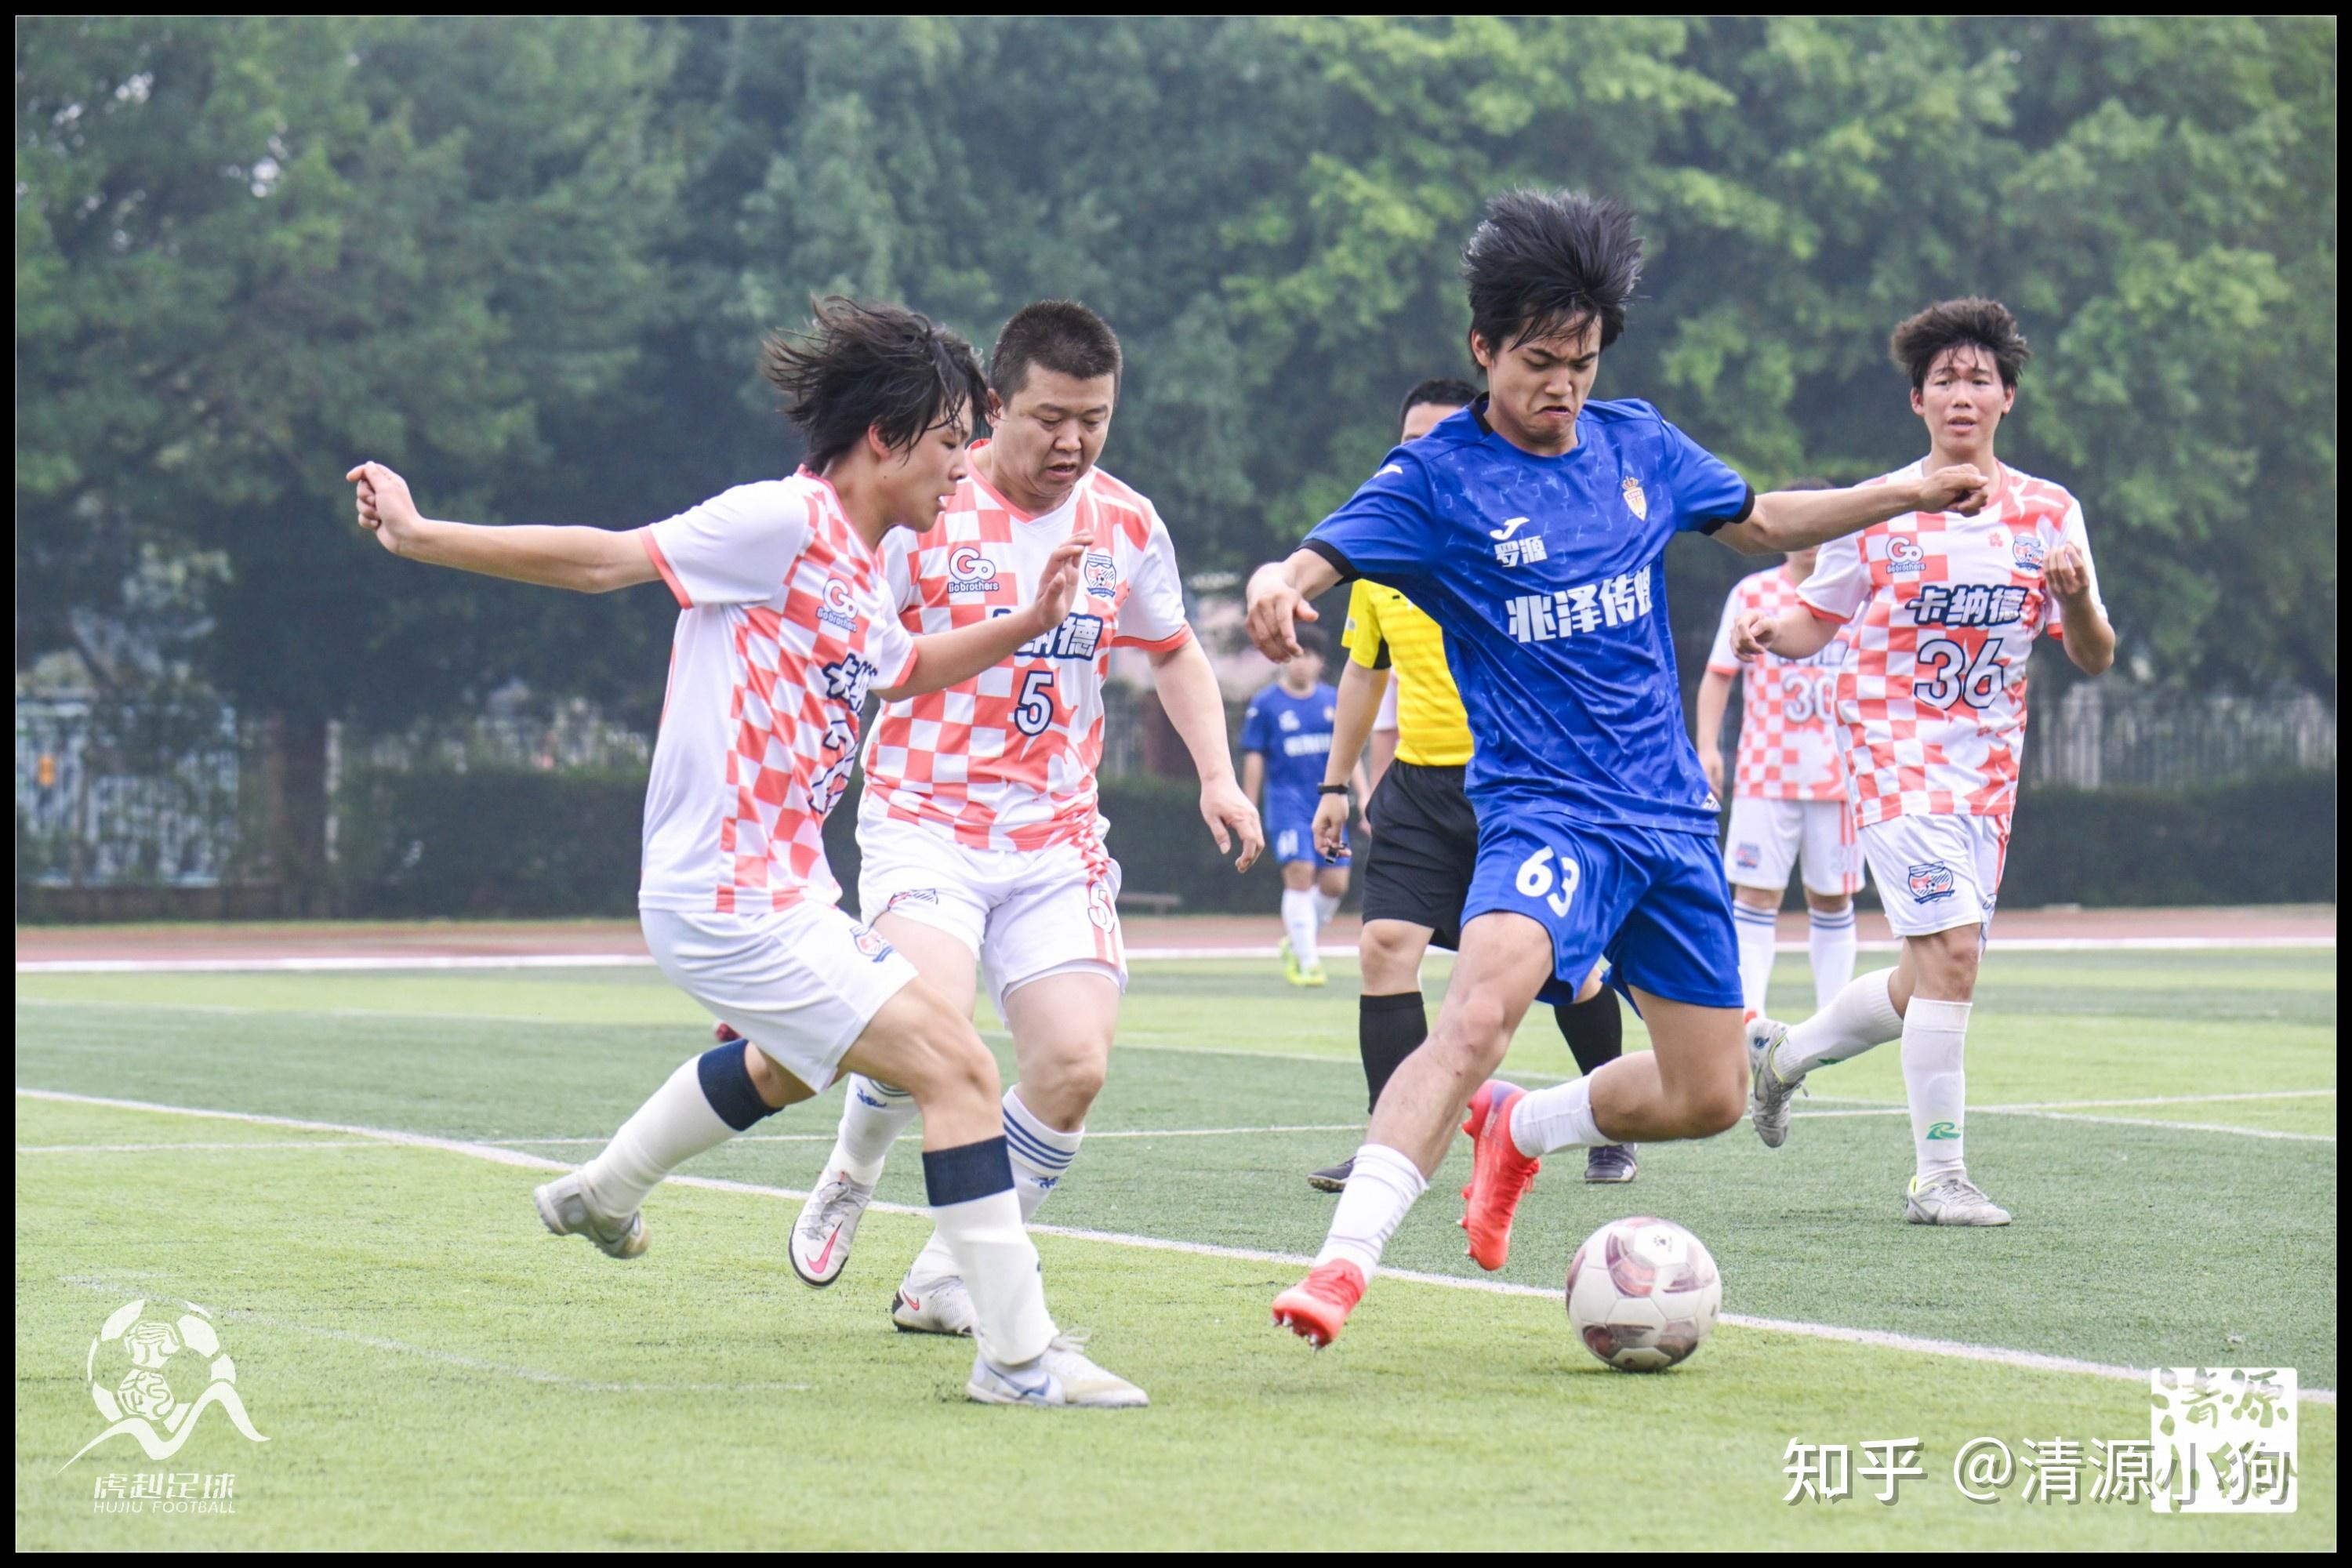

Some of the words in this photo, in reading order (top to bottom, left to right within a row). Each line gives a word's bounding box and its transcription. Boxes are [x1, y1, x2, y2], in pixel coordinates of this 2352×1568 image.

[1905, 585, 2029, 627] 卡纳德
[1014, 671, 1054, 736] 5
[1914, 638, 2004, 710] 36
[1087, 880, 1115, 934] 5
[1515, 846, 1580, 917] 63
